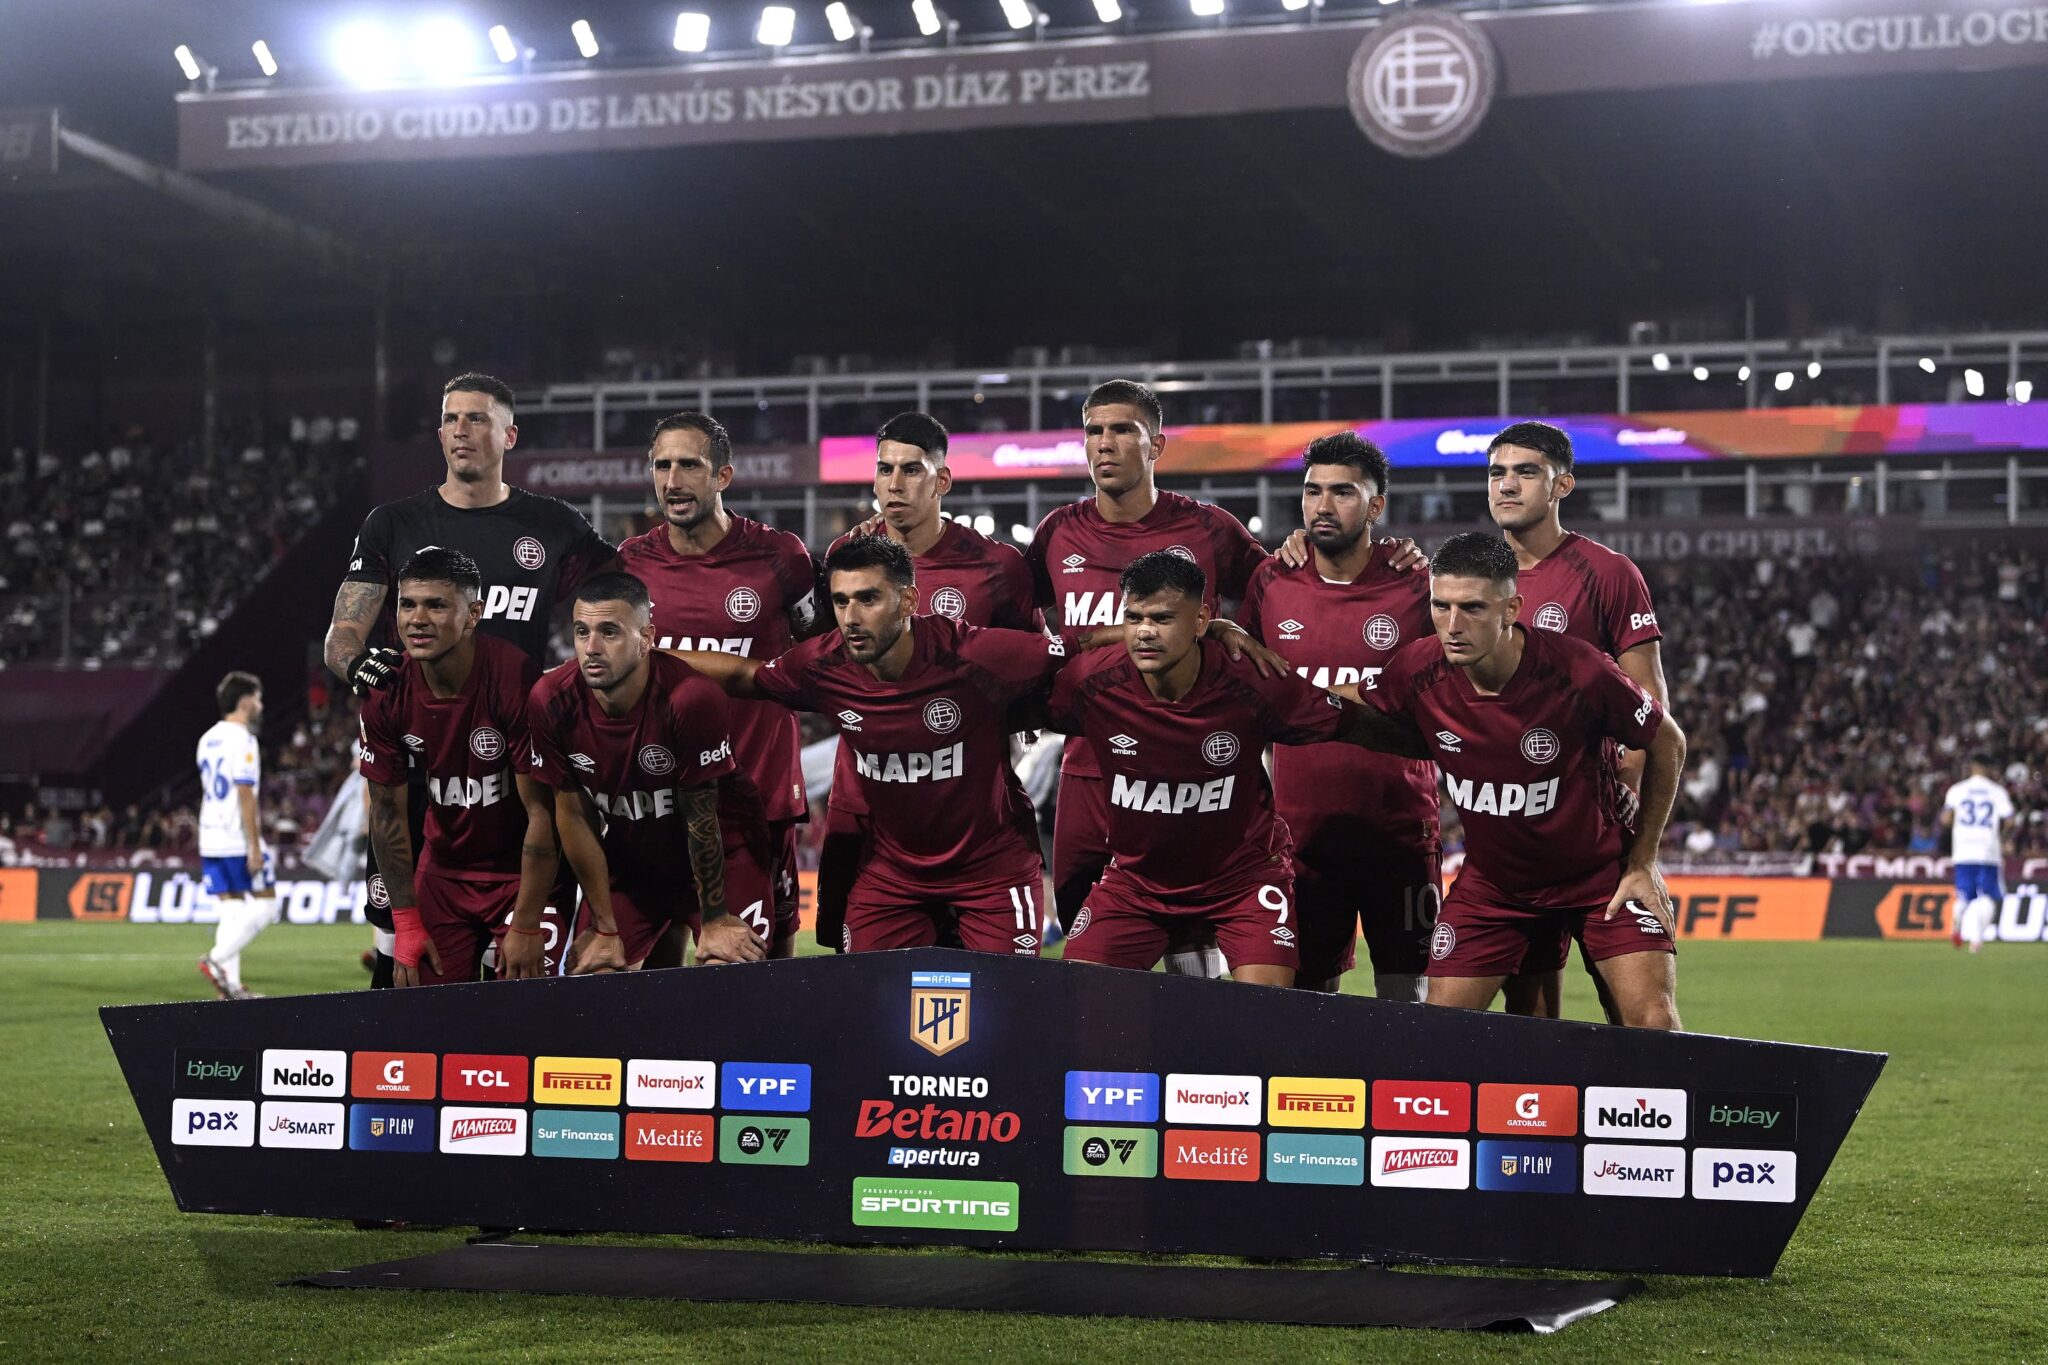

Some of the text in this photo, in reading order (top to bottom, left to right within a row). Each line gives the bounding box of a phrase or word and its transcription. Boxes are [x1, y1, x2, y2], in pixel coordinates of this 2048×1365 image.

[227, 55, 1148, 149] ESTADIO CIUDAD DE LANÚS NÉSTOR DÍAZ PÉREZ
[842, 722, 862, 732] umbro
[1112, 748, 1137, 756] umbro
[1439, 743, 1461, 753] umbro
[854, 741, 963, 783] MAPEI
[1111, 773, 1236, 814] MAPEI
[1446, 772, 1560, 816] MAPEI
[1961, 799, 1994, 828] 32
[1009, 885, 1036, 930] 11
[1257, 884, 1288, 924] 9
[1404, 882, 1440, 931] 10
[1273, 939, 1295, 948] umbro
[931, 975, 951, 984] AFA
[187, 1060, 244, 1081] bplay
[273, 1067, 334, 1087] Naldo
[383, 1060, 404, 1084] G
[461, 1069, 510, 1088] TCL
[376, 1084, 411, 1092] GATORADE
[543, 1071, 612, 1091] PIRELLI
[736, 1077, 797, 1096] YPF
[889, 1075, 989, 1098] TORNEO
[1081, 1087, 1144, 1106] YPF
[1278, 1092, 1355, 1113] PIRELLI
[1393, 1097, 1449, 1116] TCL
[1516, 1093, 1539, 1119] G
[188, 1111, 238, 1134] pax
[269, 1116, 335, 1135] JetSMART
[389, 1118, 414, 1135] PLAY
[855, 1100, 1021, 1142] Betano
[1507, 1119, 1547, 1128] GATORADE
[1599, 1107, 1672, 1129] Naldo
[1709, 1105, 1780, 1128] bplay
[453, 1118, 514, 1138] MANTECOL
[538, 1128, 614, 1141] Sur Finanzas
[636, 1128, 703, 1148] Medifé
[742, 1132, 760, 1142] EA
[892, 1147, 980, 1168] apertura
[1086, 1143, 1106, 1154] EA
[1176, 1146, 1249, 1166] Medifé
[1273, 1153, 1358, 1167] Sur Finanzas
[1385, 1151, 1454, 1170] MANTECOL
[1523, 1156, 1552, 1174] PLAY
[1594, 1159, 1675, 1182] JetSMART
[1712, 1161, 1775, 1188] pax
[863, 1188, 914, 1196] PRESENTADO
[861, 1197, 1010, 1216] SPORTING
